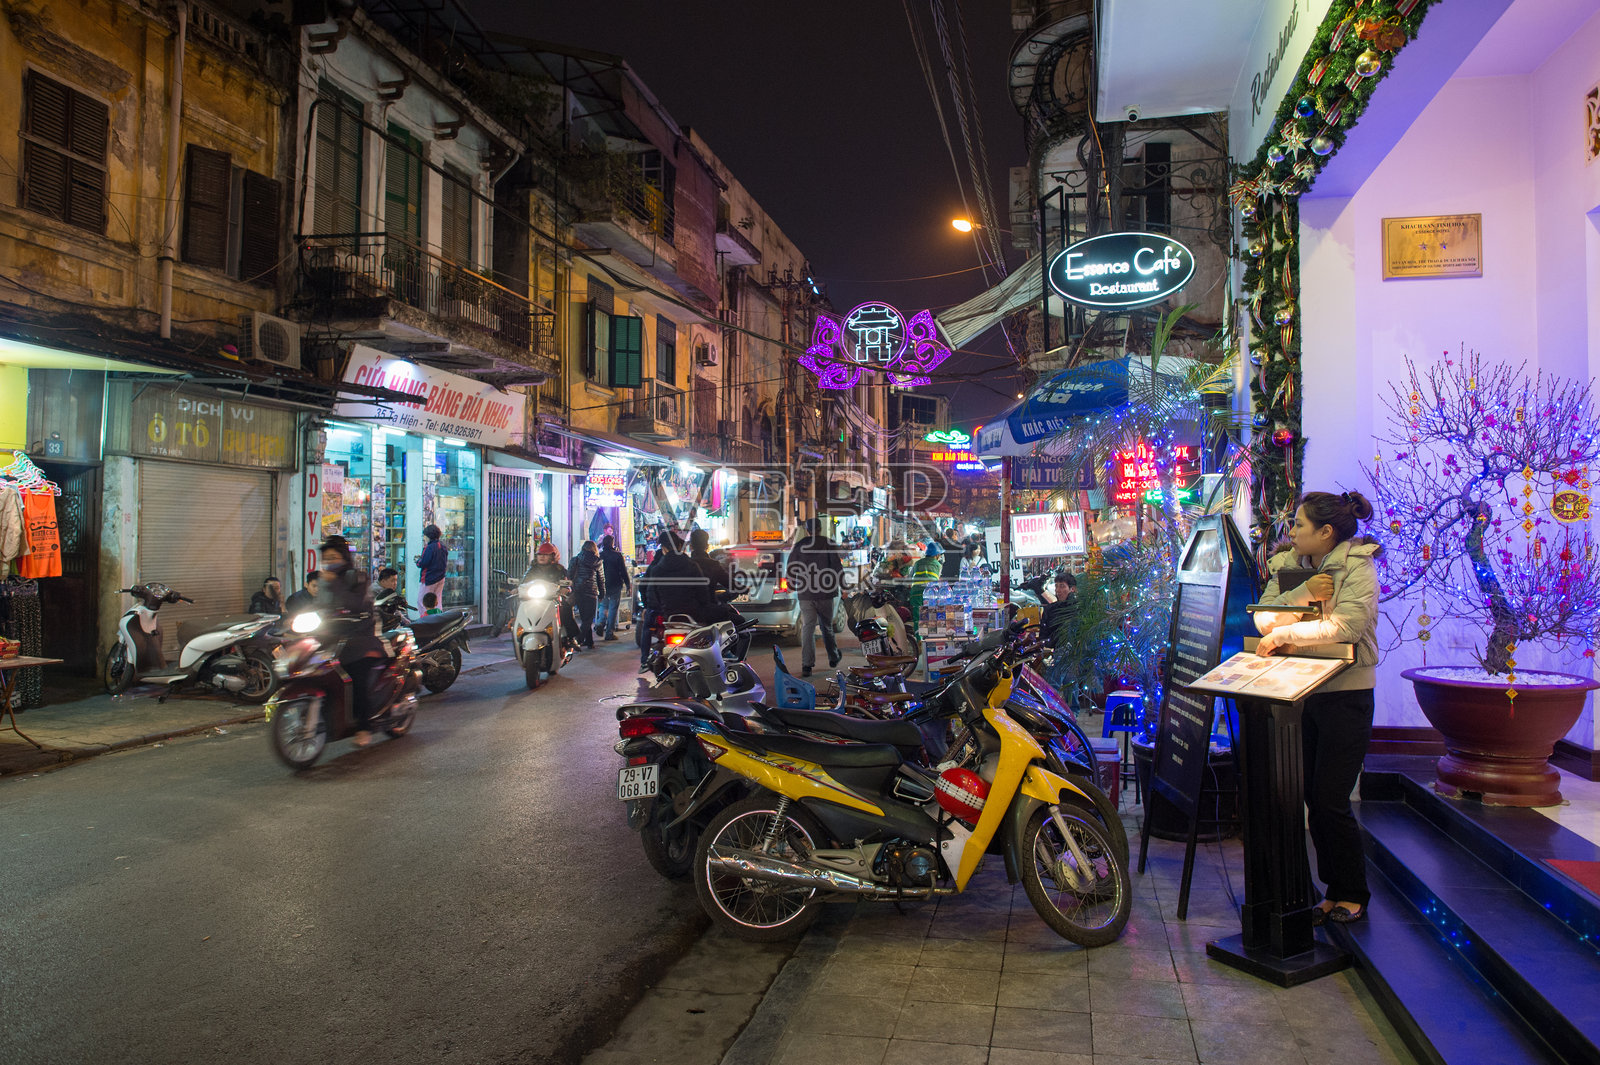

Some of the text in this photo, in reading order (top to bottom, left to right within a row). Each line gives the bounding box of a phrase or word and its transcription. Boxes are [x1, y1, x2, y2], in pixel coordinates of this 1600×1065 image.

[1065, 245, 1181, 280] Essence Café
[1090, 278, 1160, 296] Restaurant
[178, 398, 255, 423] DỊCH VỤ
[424, 382, 461, 419] BĂNG
[459, 391, 483, 422] ĐĨA
[480, 400, 514, 433] NHẠC
[148, 412, 168, 443] Ô
[175, 419, 210, 448] TÔ
[400, 412, 419, 429] Hiện
[426, 418, 438, 432] Tel:
[439, 422, 484, 440] 043.9263871
[1021, 419, 1046, 438] KHÁC
[48, 442, 61, 454] 33
[932, 452, 944, 461] KHU
[944, 450, 956, 461] BẢO
[1016, 518, 1047, 533] KHOAI
[623, 766, 653, 783] 29-V7
[620, 780, 656, 798] 068.18
